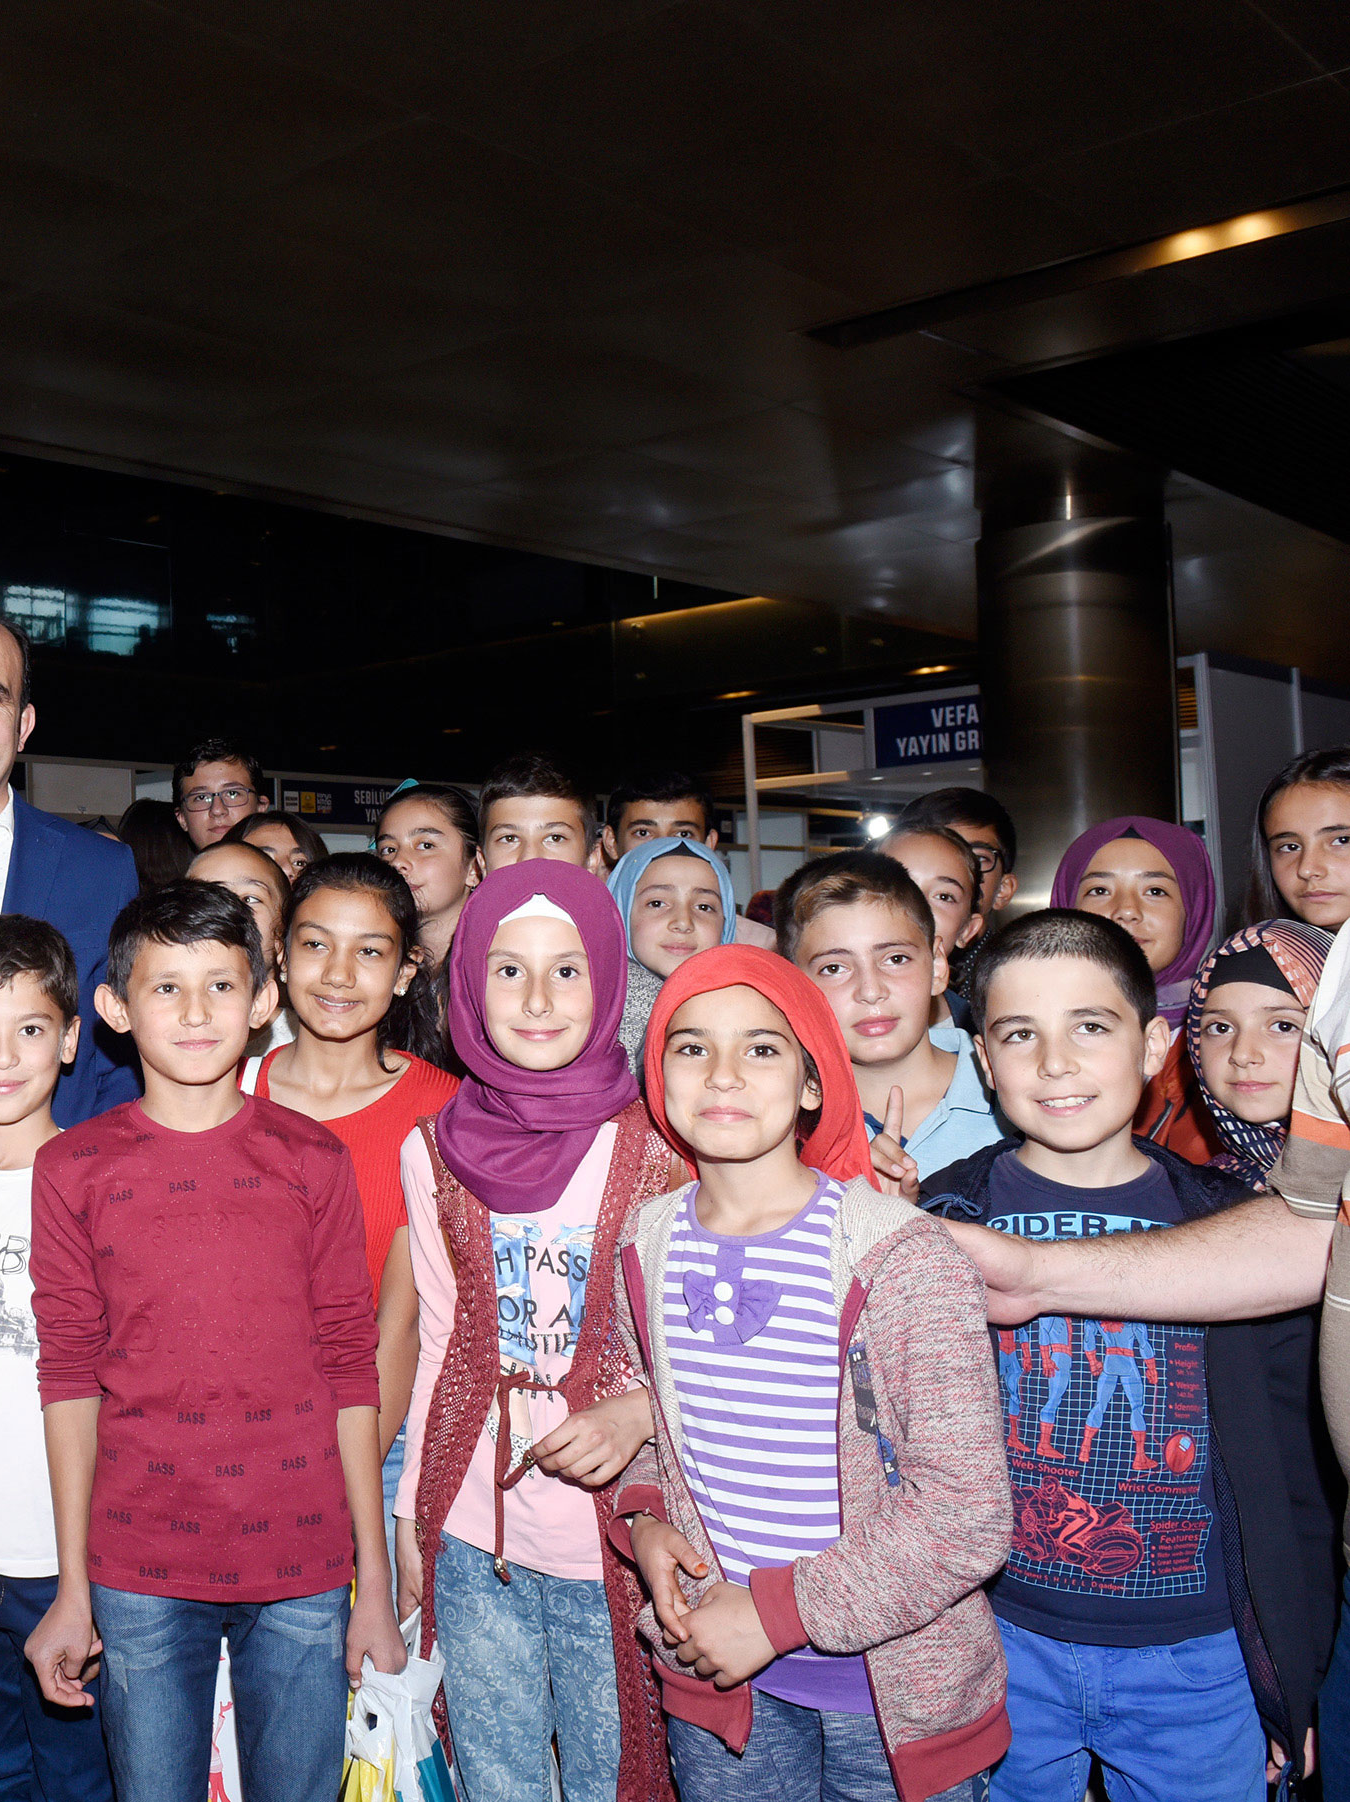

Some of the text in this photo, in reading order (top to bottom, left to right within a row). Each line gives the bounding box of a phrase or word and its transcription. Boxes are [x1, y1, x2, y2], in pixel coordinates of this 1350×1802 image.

[931, 704, 979, 728] VEFA
[896, 730, 981, 757] YAYIN GR
[523, 1246, 588, 1283] PASS
[497, 1294, 538, 1329] OR
[1011, 1458, 1080, 1478] Web-Shooter
[1118, 1482, 1146, 1494] Wrist
[1150, 1520, 1179, 1532] Spider
